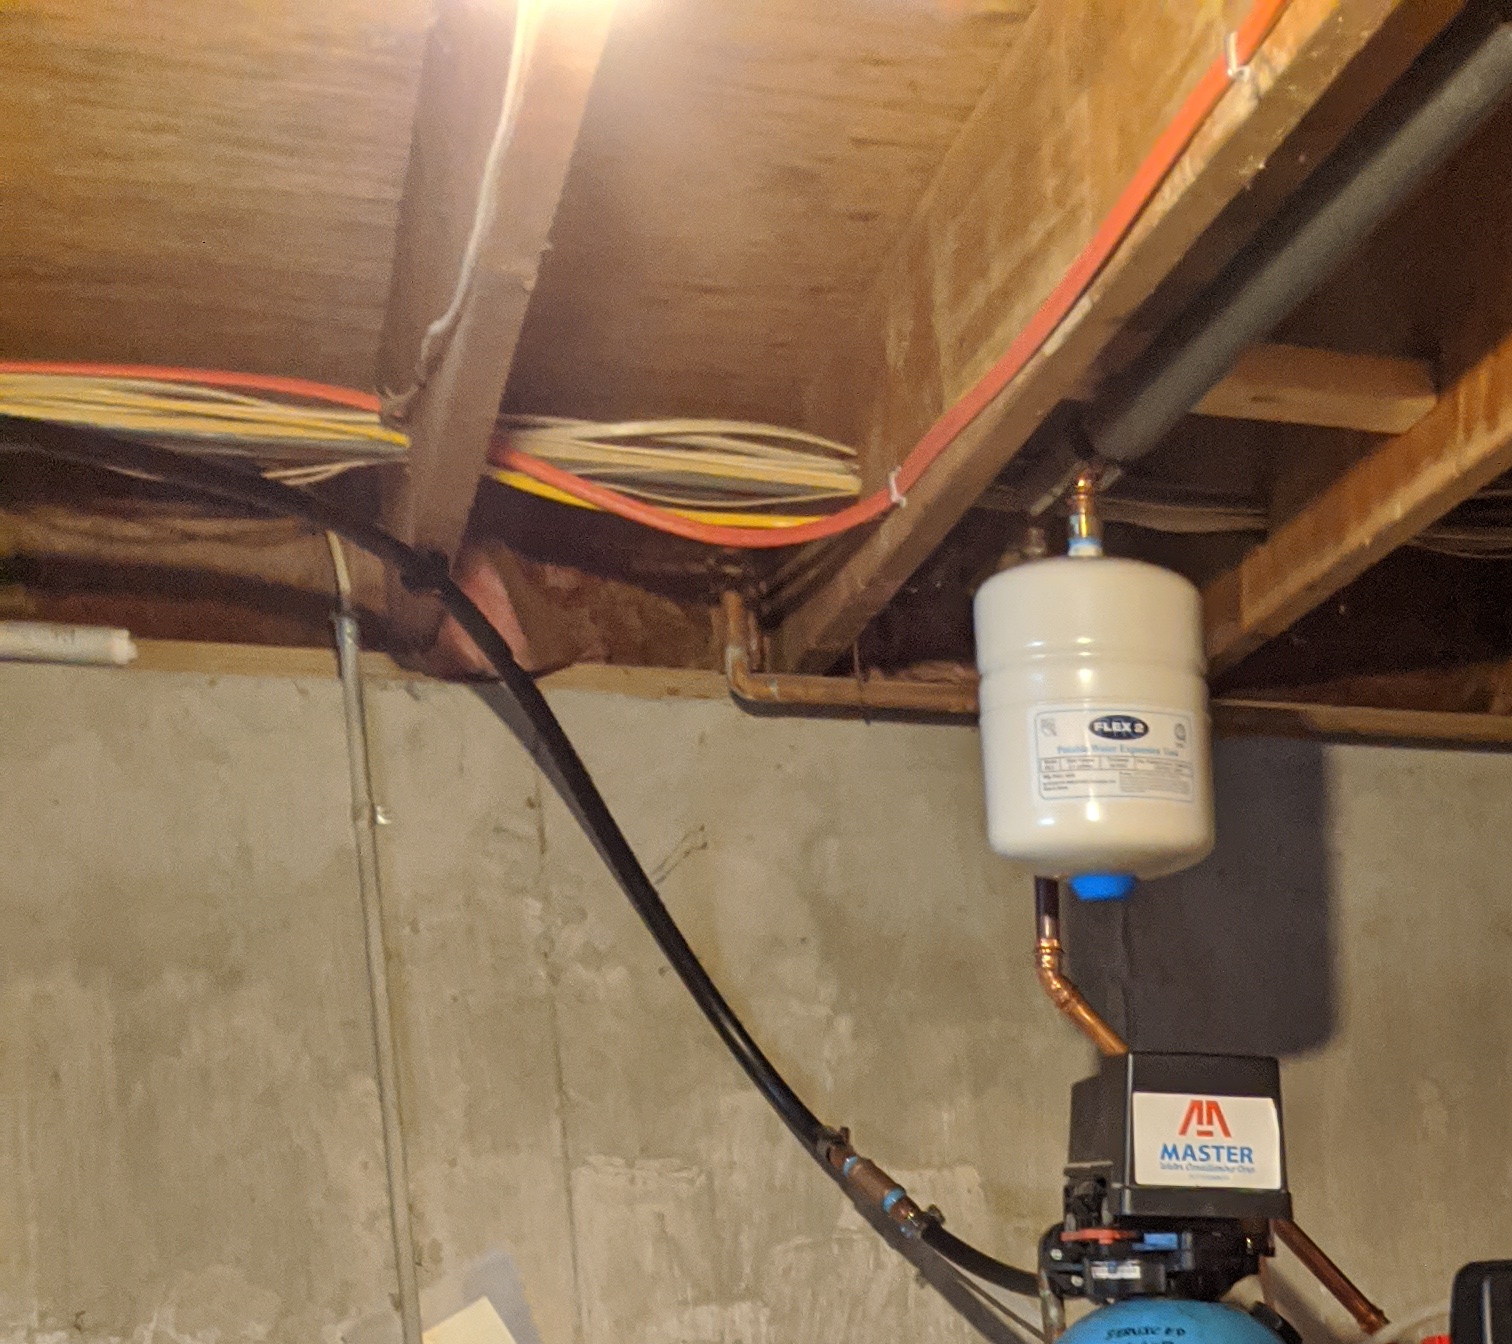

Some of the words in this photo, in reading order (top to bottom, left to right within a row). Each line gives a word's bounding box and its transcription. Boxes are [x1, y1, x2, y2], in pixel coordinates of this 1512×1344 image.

[1093, 721, 1132, 734] FLEX
[1133, 721, 1145, 734] 2
[1160, 1143, 1254, 1164] MASTER
